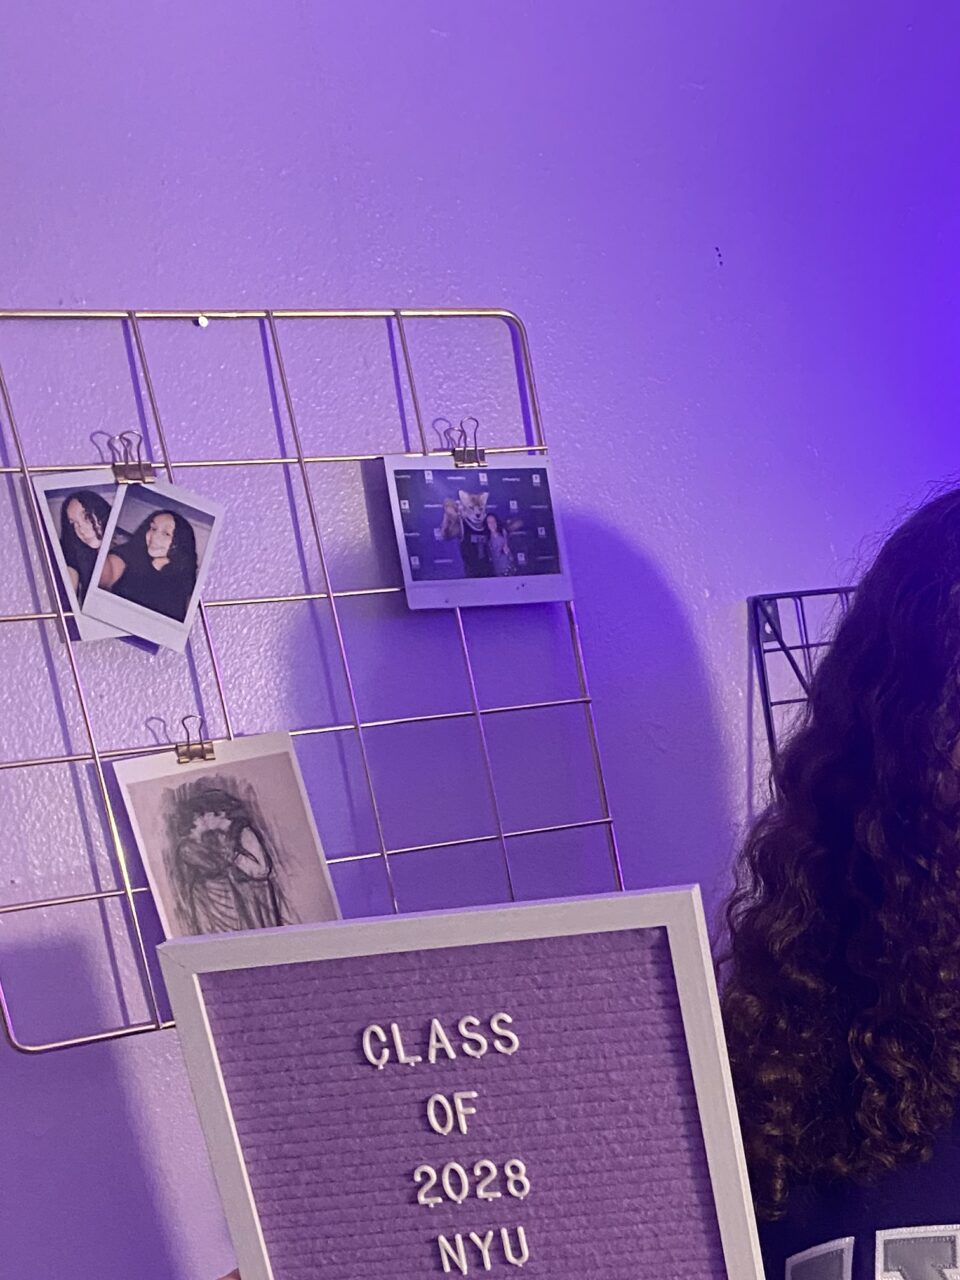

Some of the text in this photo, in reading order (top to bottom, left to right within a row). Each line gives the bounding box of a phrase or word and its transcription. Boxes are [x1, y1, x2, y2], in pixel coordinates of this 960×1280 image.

[362, 1012, 520, 1069] CLASS
[426, 1090, 478, 1135] OF
[413, 1158, 531, 1208] 2028
[437, 1226, 530, 1275] NYU
